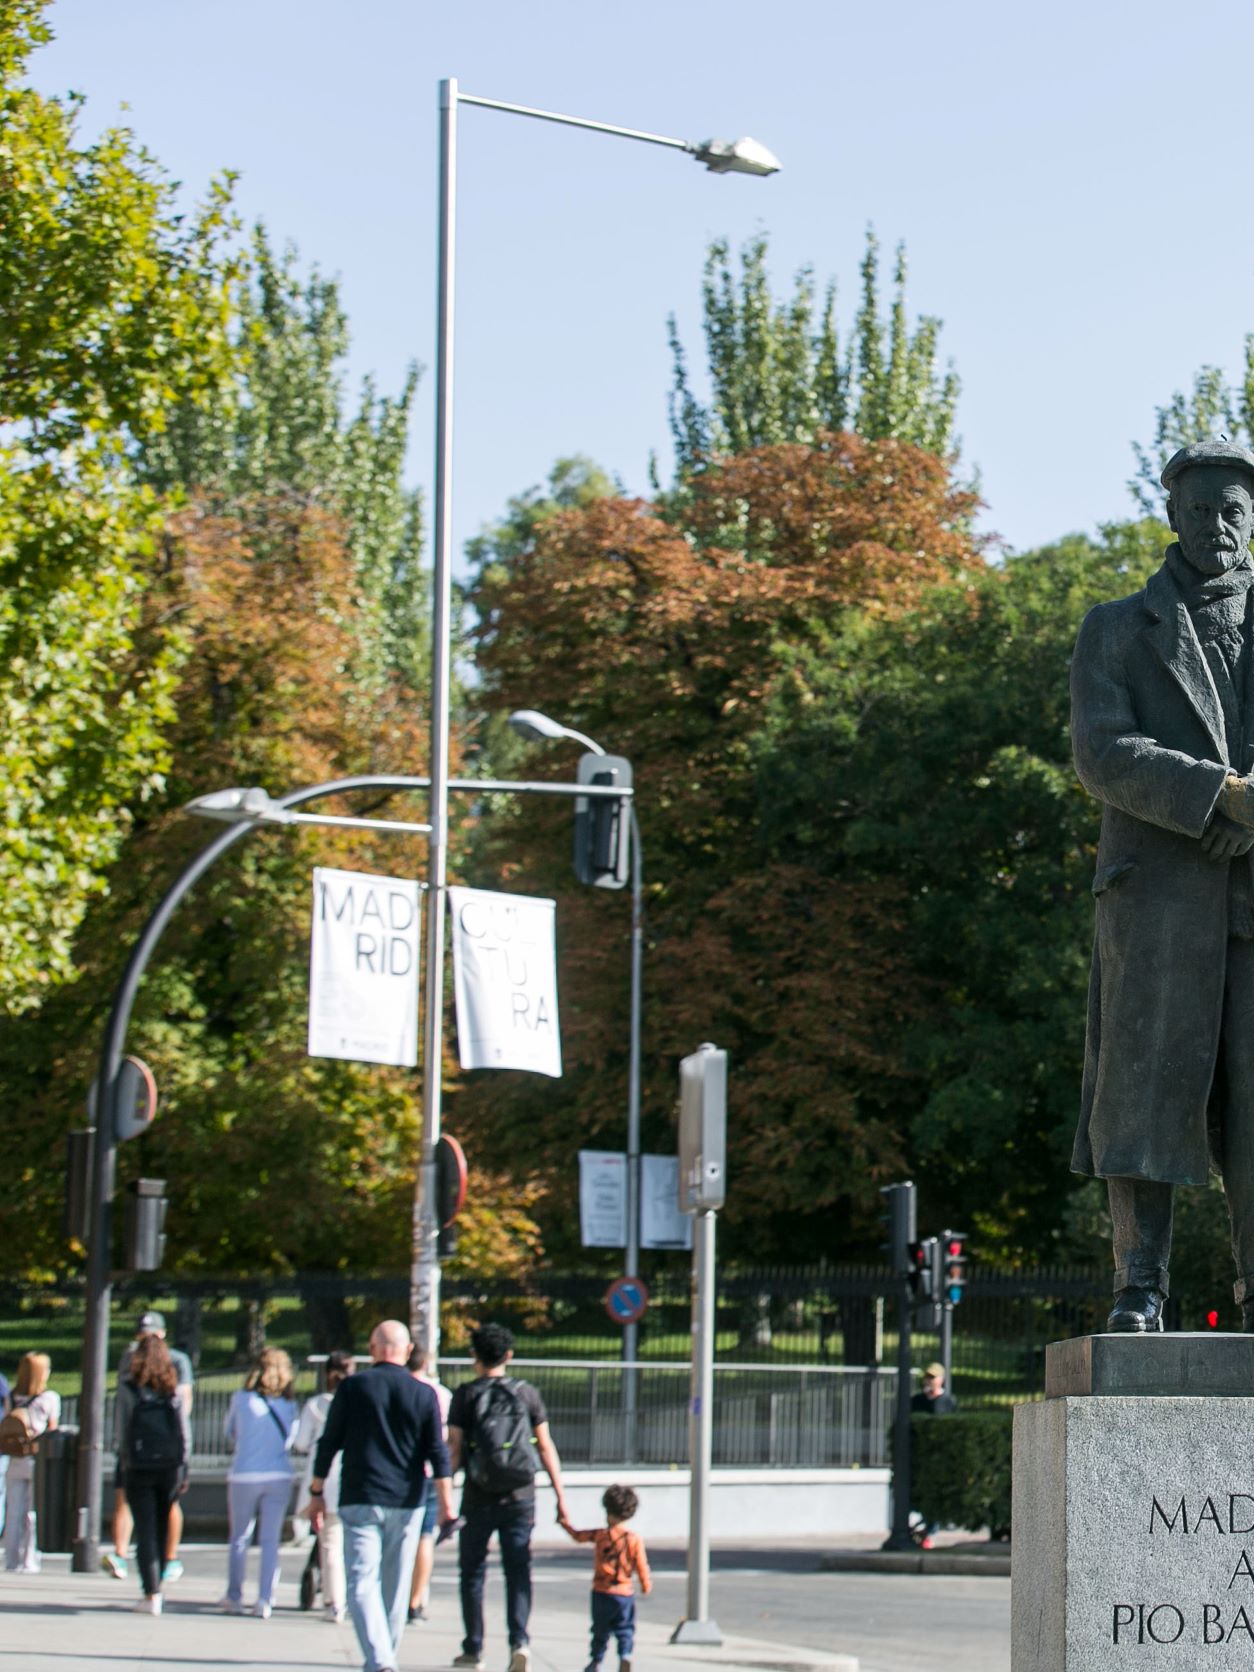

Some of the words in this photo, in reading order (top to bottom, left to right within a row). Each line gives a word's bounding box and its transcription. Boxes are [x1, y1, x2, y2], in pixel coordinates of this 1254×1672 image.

[319, 881, 415, 931] MAD
[355, 932, 413, 976] RID
[511, 992, 552, 1034] RA
[1112, 1603, 1185, 1645] PIO
